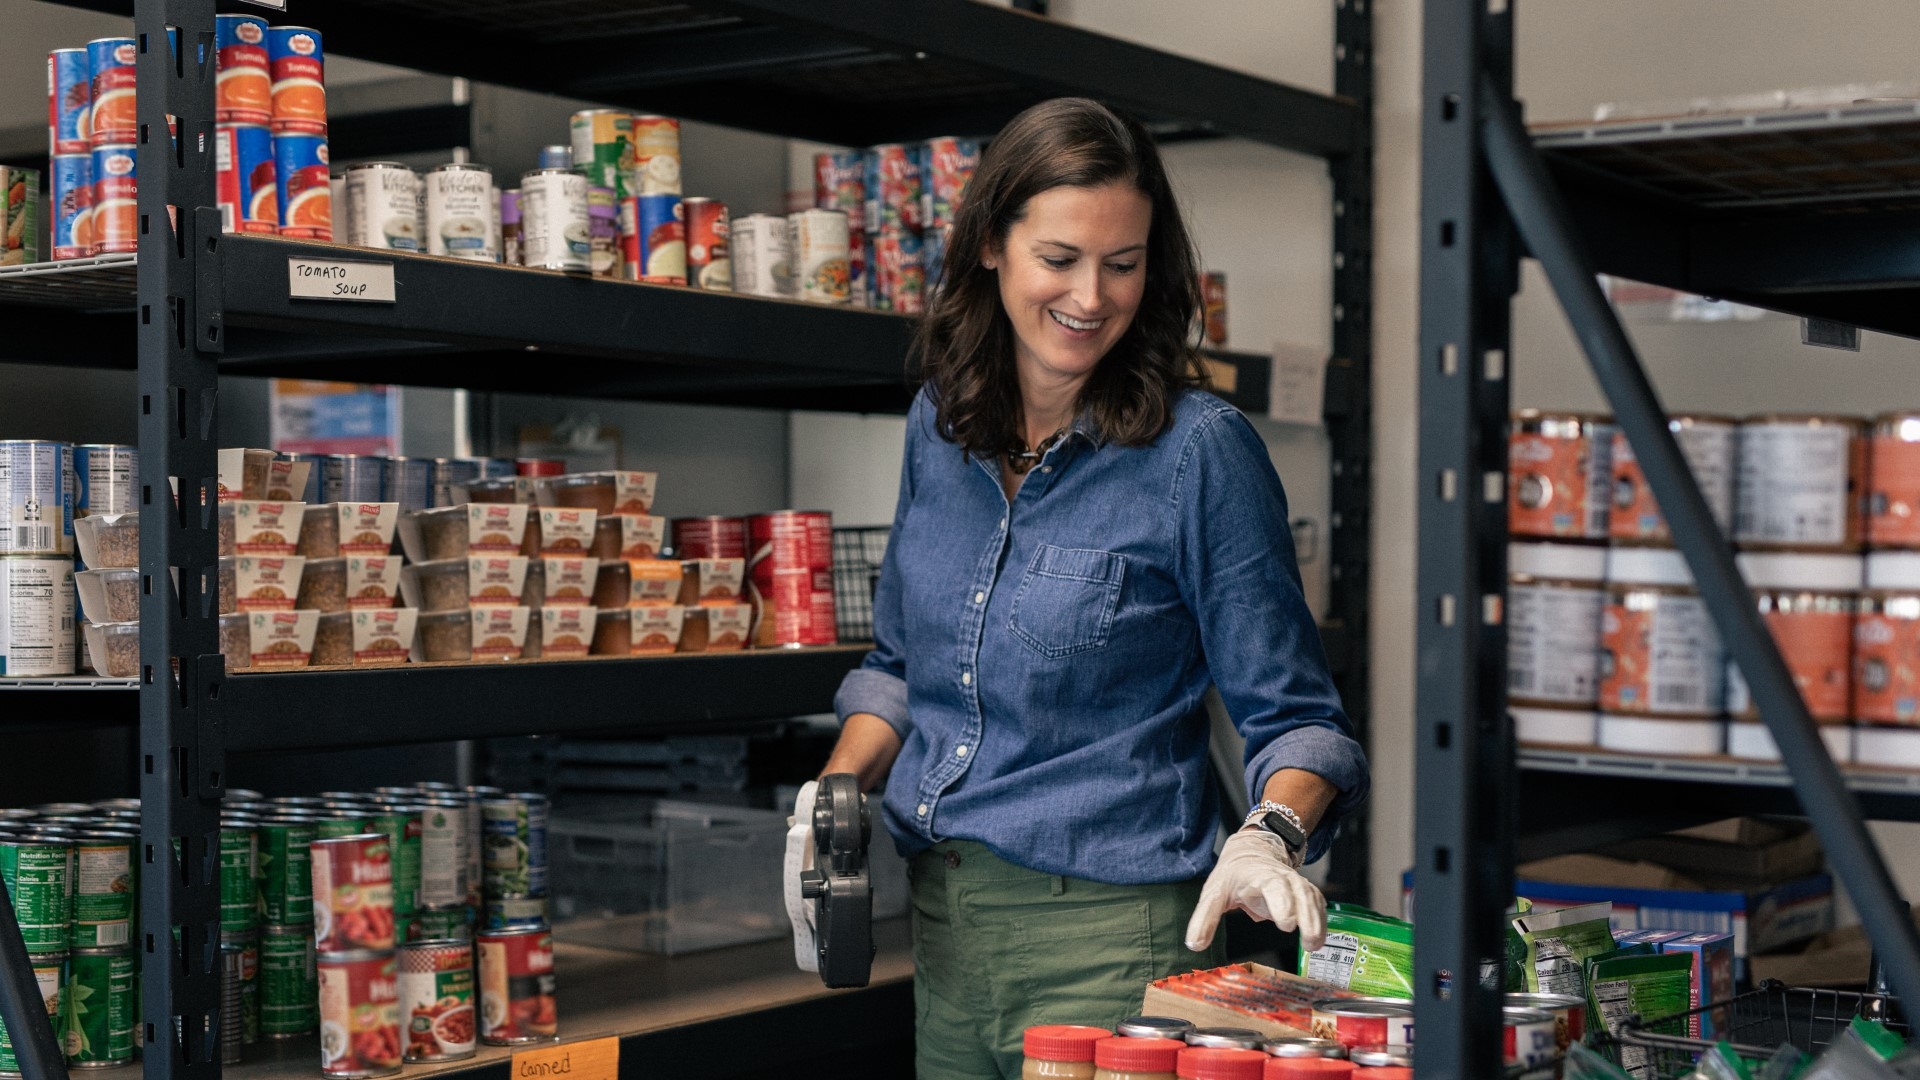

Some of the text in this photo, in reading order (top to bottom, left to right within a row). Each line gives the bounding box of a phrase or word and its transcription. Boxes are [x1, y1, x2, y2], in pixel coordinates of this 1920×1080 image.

[296, 264, 347, 279] TOMATO
[332, 282, 367, 297] SOUP
[43, 588, 54, 596] 70
[20, 852, 51, 860] Nutrition
[1340, 935, 1358, 944] Facts
[1330, 953, 1341, 962] 200
[1343, 955, 1355, 964] 410
[1594, 980, 1629, 990] Nutrition Facts
[520, 1051, 571, 1078] Canned
